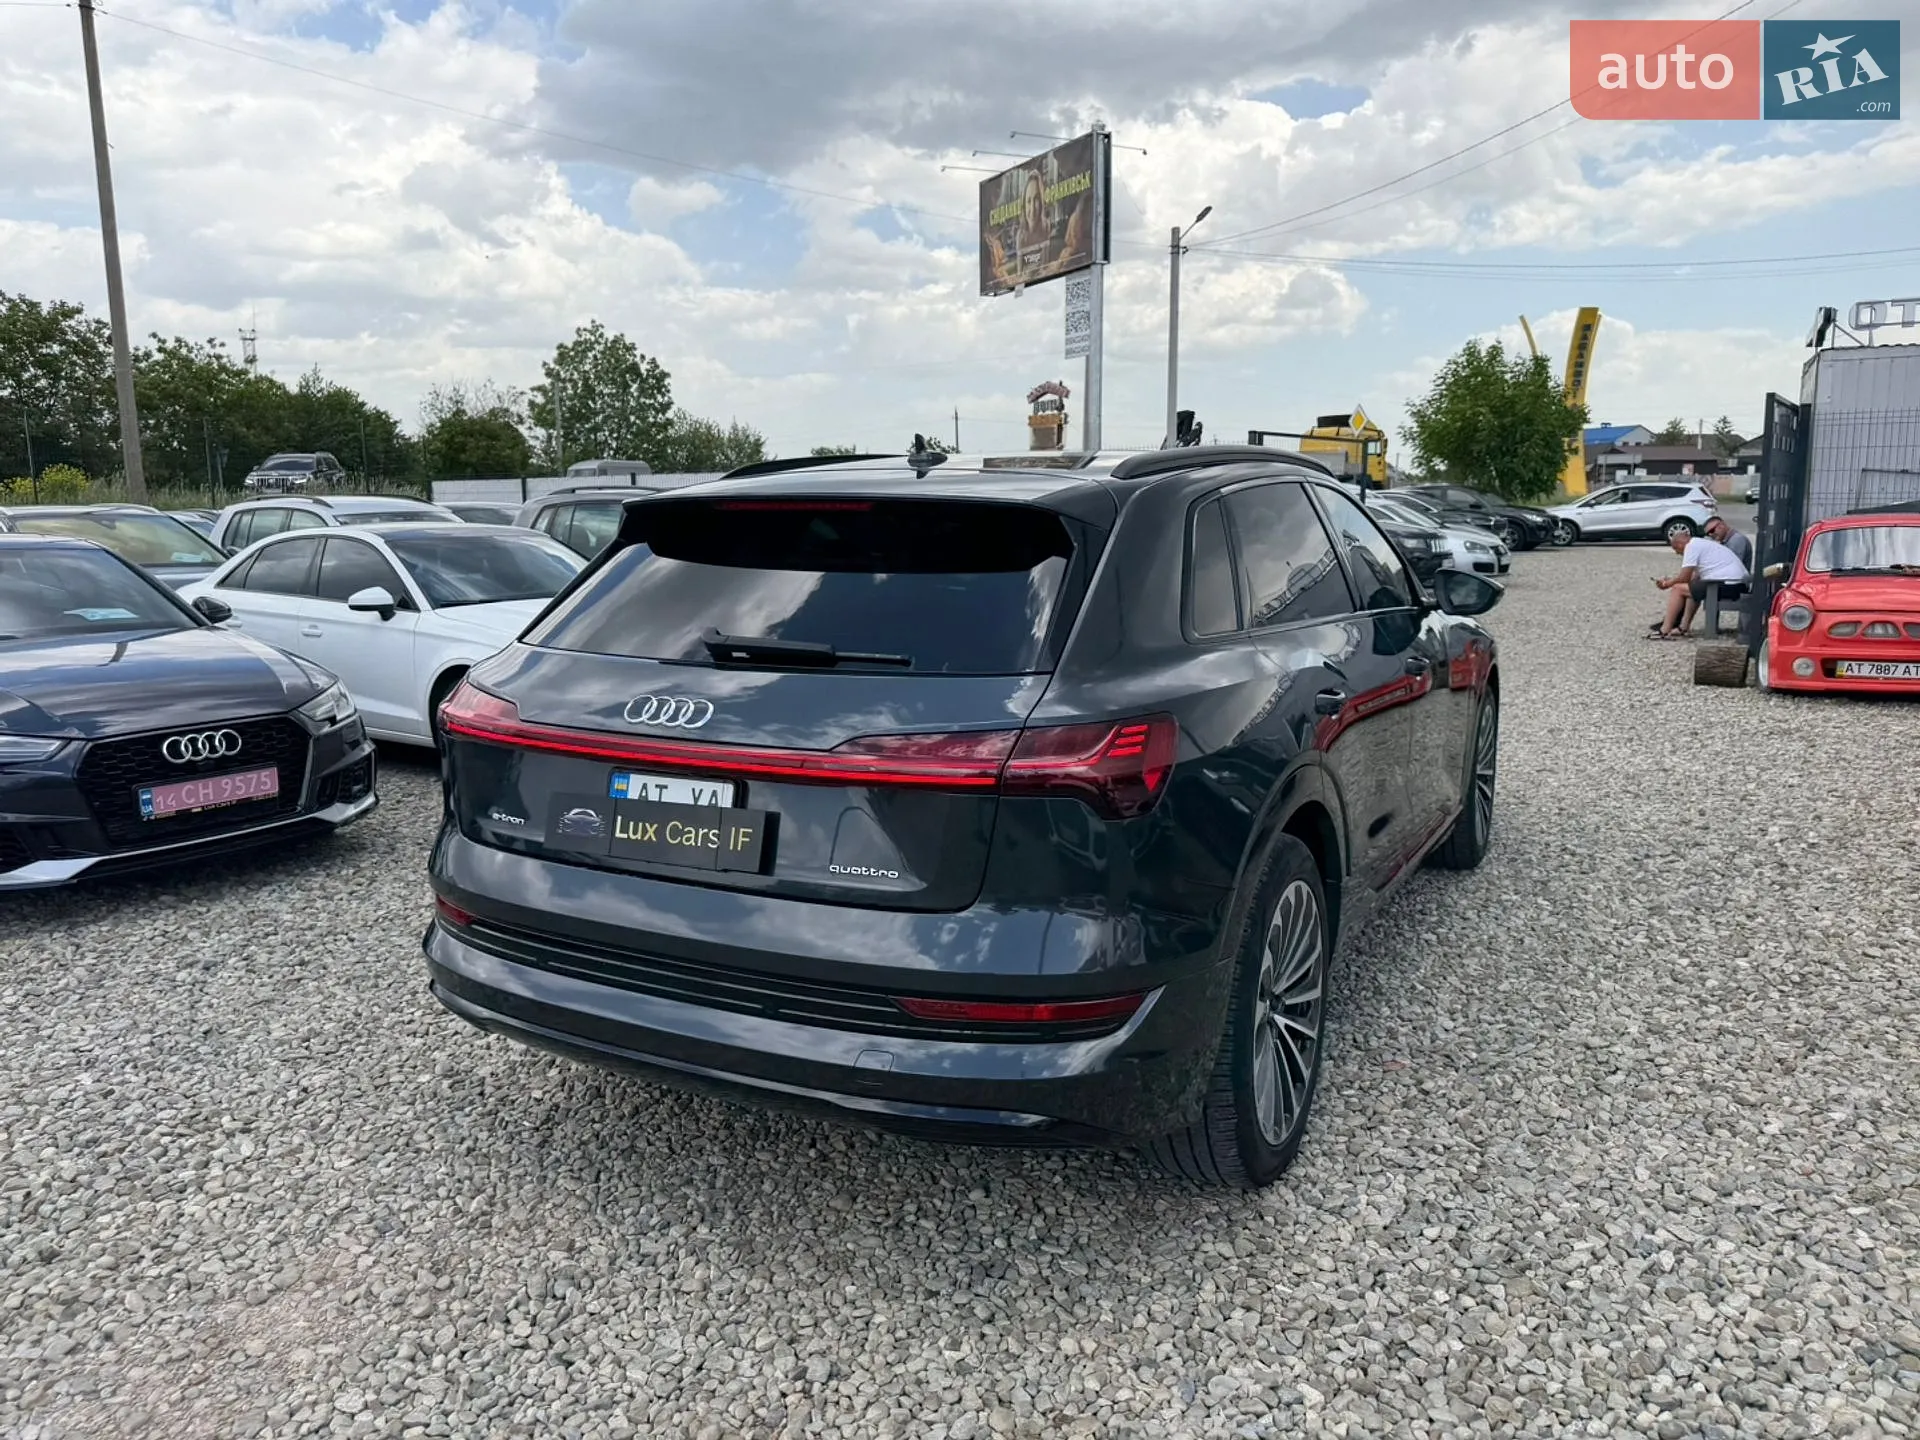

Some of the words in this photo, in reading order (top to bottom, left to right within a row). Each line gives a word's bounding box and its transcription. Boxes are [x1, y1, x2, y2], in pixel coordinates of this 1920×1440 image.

[1846, 663, 1864, 674] AT
[1868, 664, 1899, 676] 7887
[1902, 665, 1920, 677] AT
[155, 792, 176, 809] 14
[181, 780, 214, 804] CH
[221, 772, 271, 797] 9575
[615, 815, 658, 842] Lux
[666, 821, 720, 848] Cars
[729, 827, 753, 851] IF
[829, 864, 899, 879] quattro
